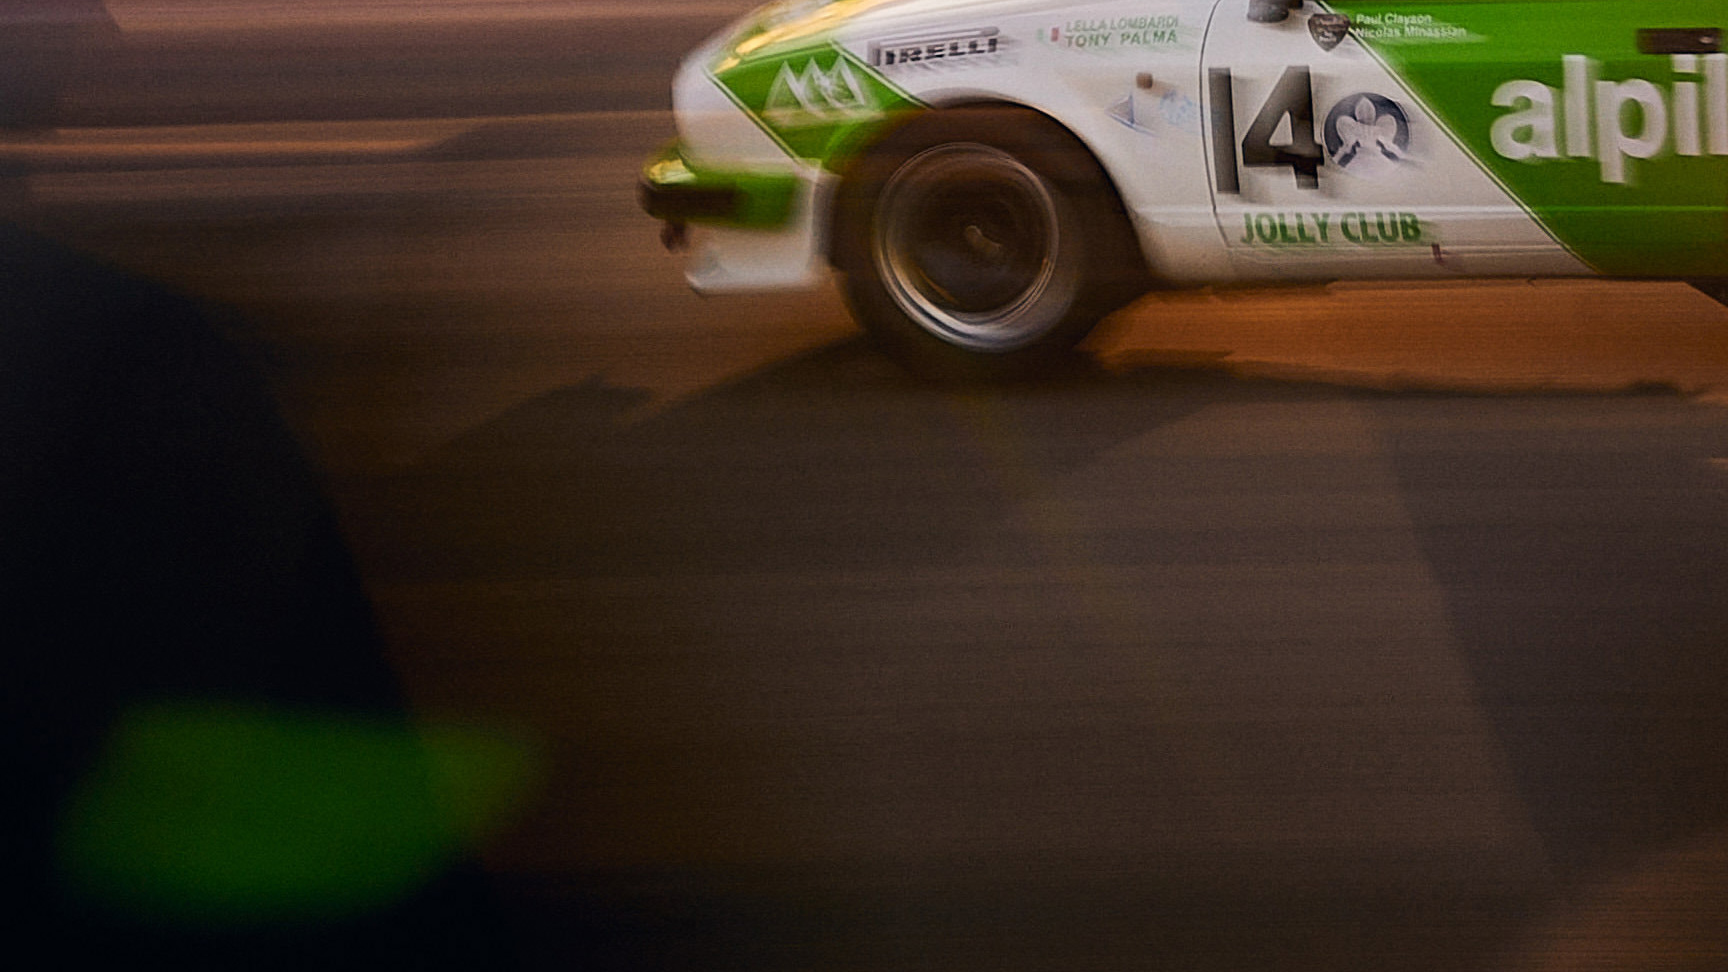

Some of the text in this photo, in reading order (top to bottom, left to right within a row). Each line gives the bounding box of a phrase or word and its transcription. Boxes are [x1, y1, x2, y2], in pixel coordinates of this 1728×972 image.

[1355, 13, 1382, 26] Paul
[1065, 29, 1178, 48] TONY PALMA
[1241, 211, 1423, 245] JOLLY CLUB
